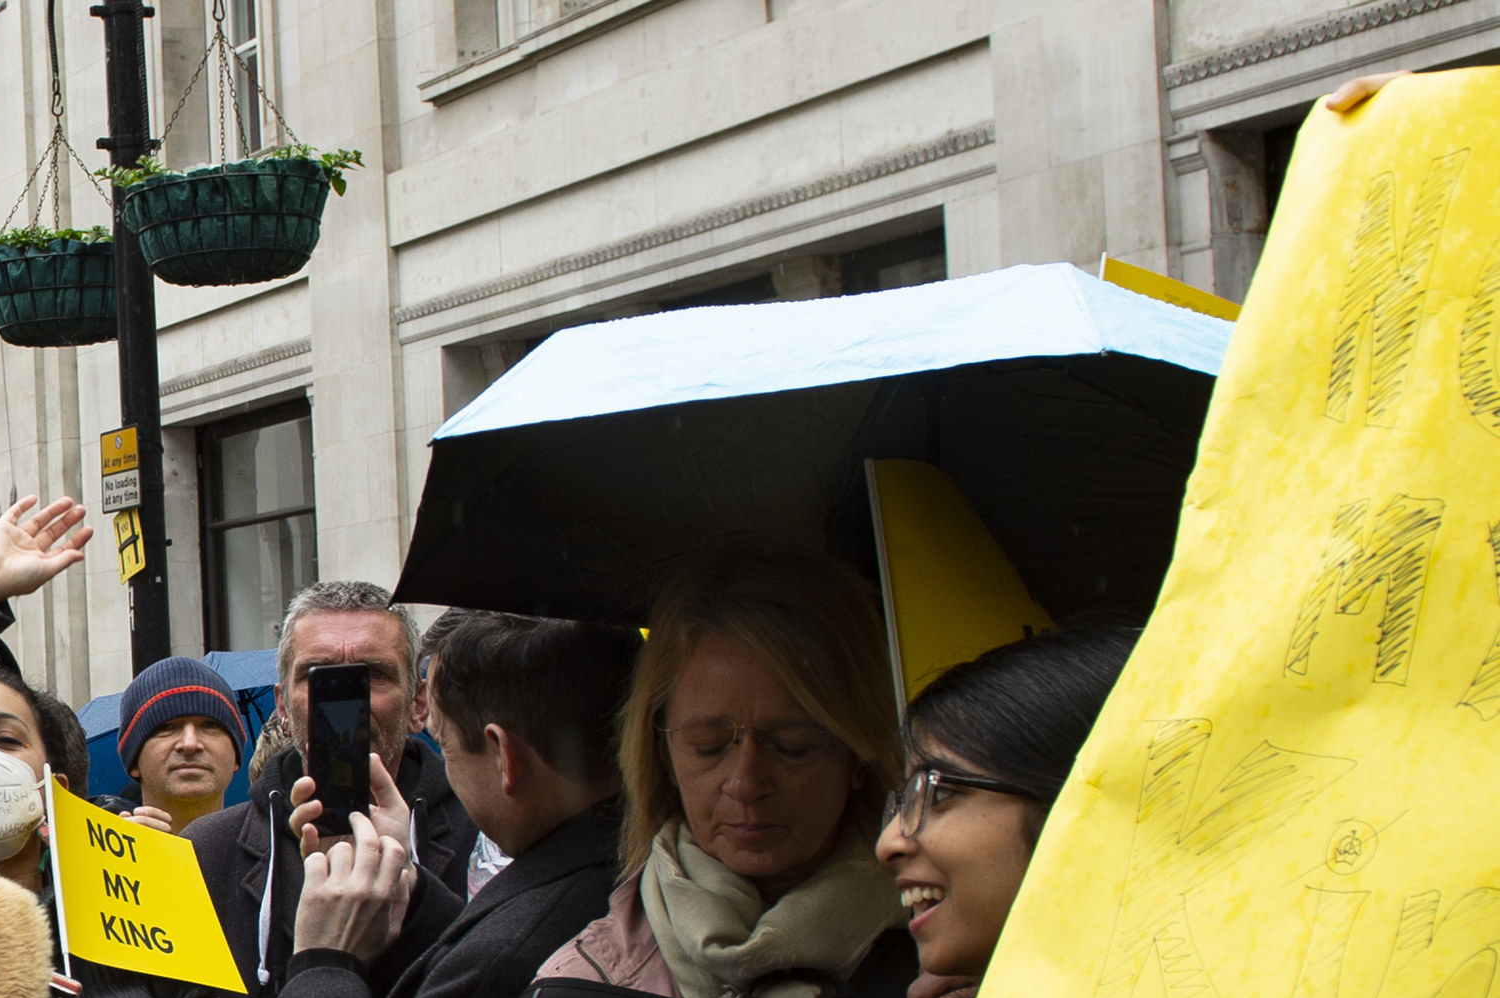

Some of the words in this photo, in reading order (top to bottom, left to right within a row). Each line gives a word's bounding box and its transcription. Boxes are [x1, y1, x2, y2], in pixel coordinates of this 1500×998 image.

[104, 456, 111, 468] At
[111, 457, 122, 468] any
[123, 453, 137, 464] time
[105, 481, 114, 492] No
[114, 476, 138, 489] loading
[105, 495, 111, 505] at
[112, 494, 123, 505] any
[124, 490, 138, 501] time
[86, 817, 137, 863] NOT
[102, 868, 141, 906] MY
[100, 911, 174, 954] KING
